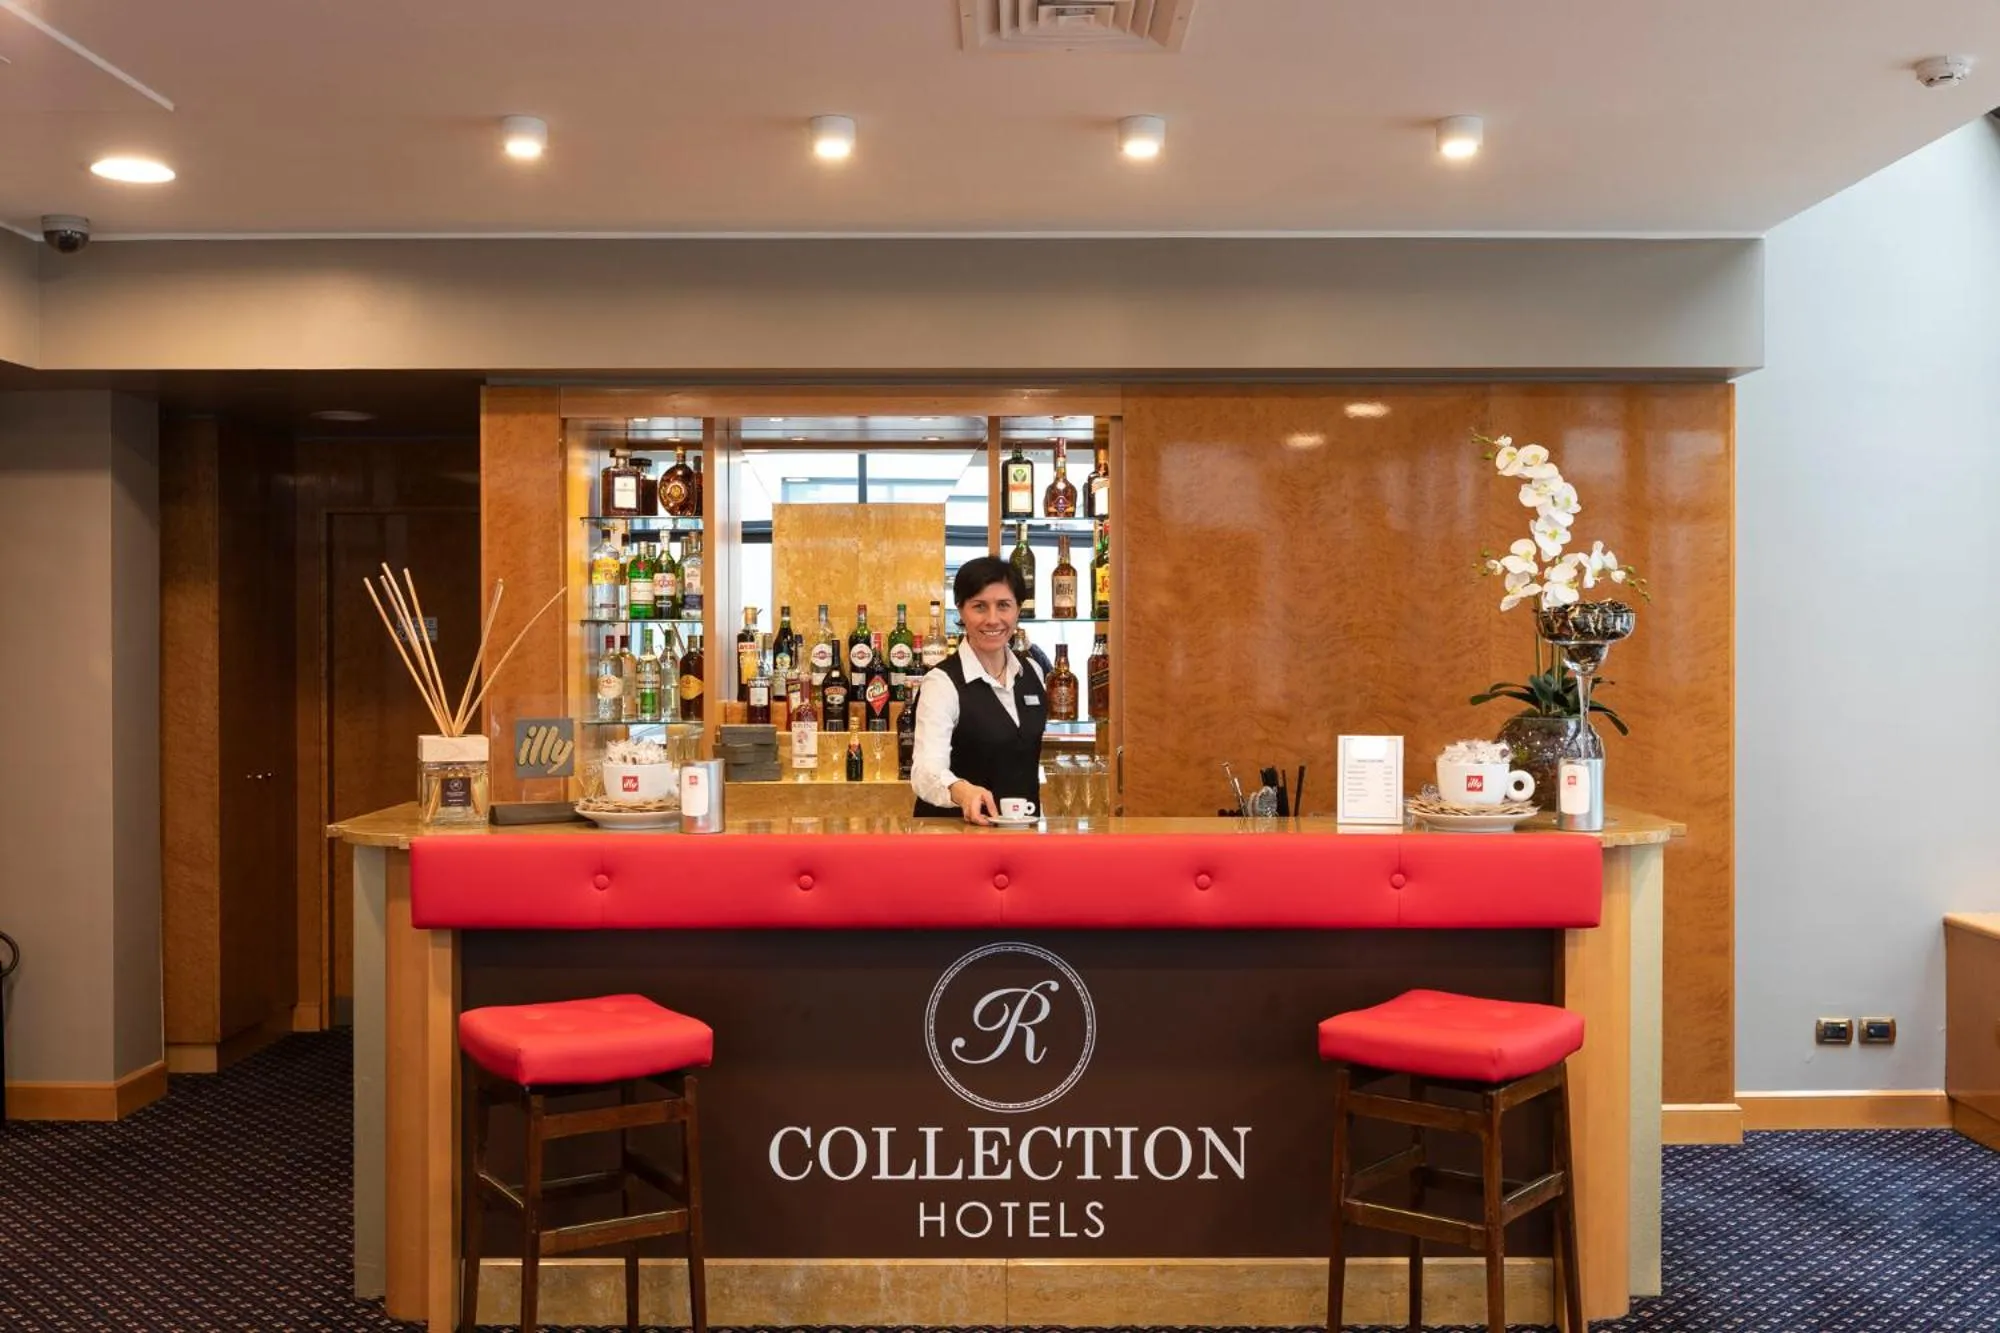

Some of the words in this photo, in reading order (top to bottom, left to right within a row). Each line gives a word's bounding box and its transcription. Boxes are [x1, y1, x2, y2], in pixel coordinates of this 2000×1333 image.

[518, 725, 574, 775] illy
[1467, 776, 1483, 789] illy
[951, 980, 1060, 1065] R
[768, 1126, 1252, 1181] COLLECTION
[919, 1201, 1105, 1238] HOTELS
